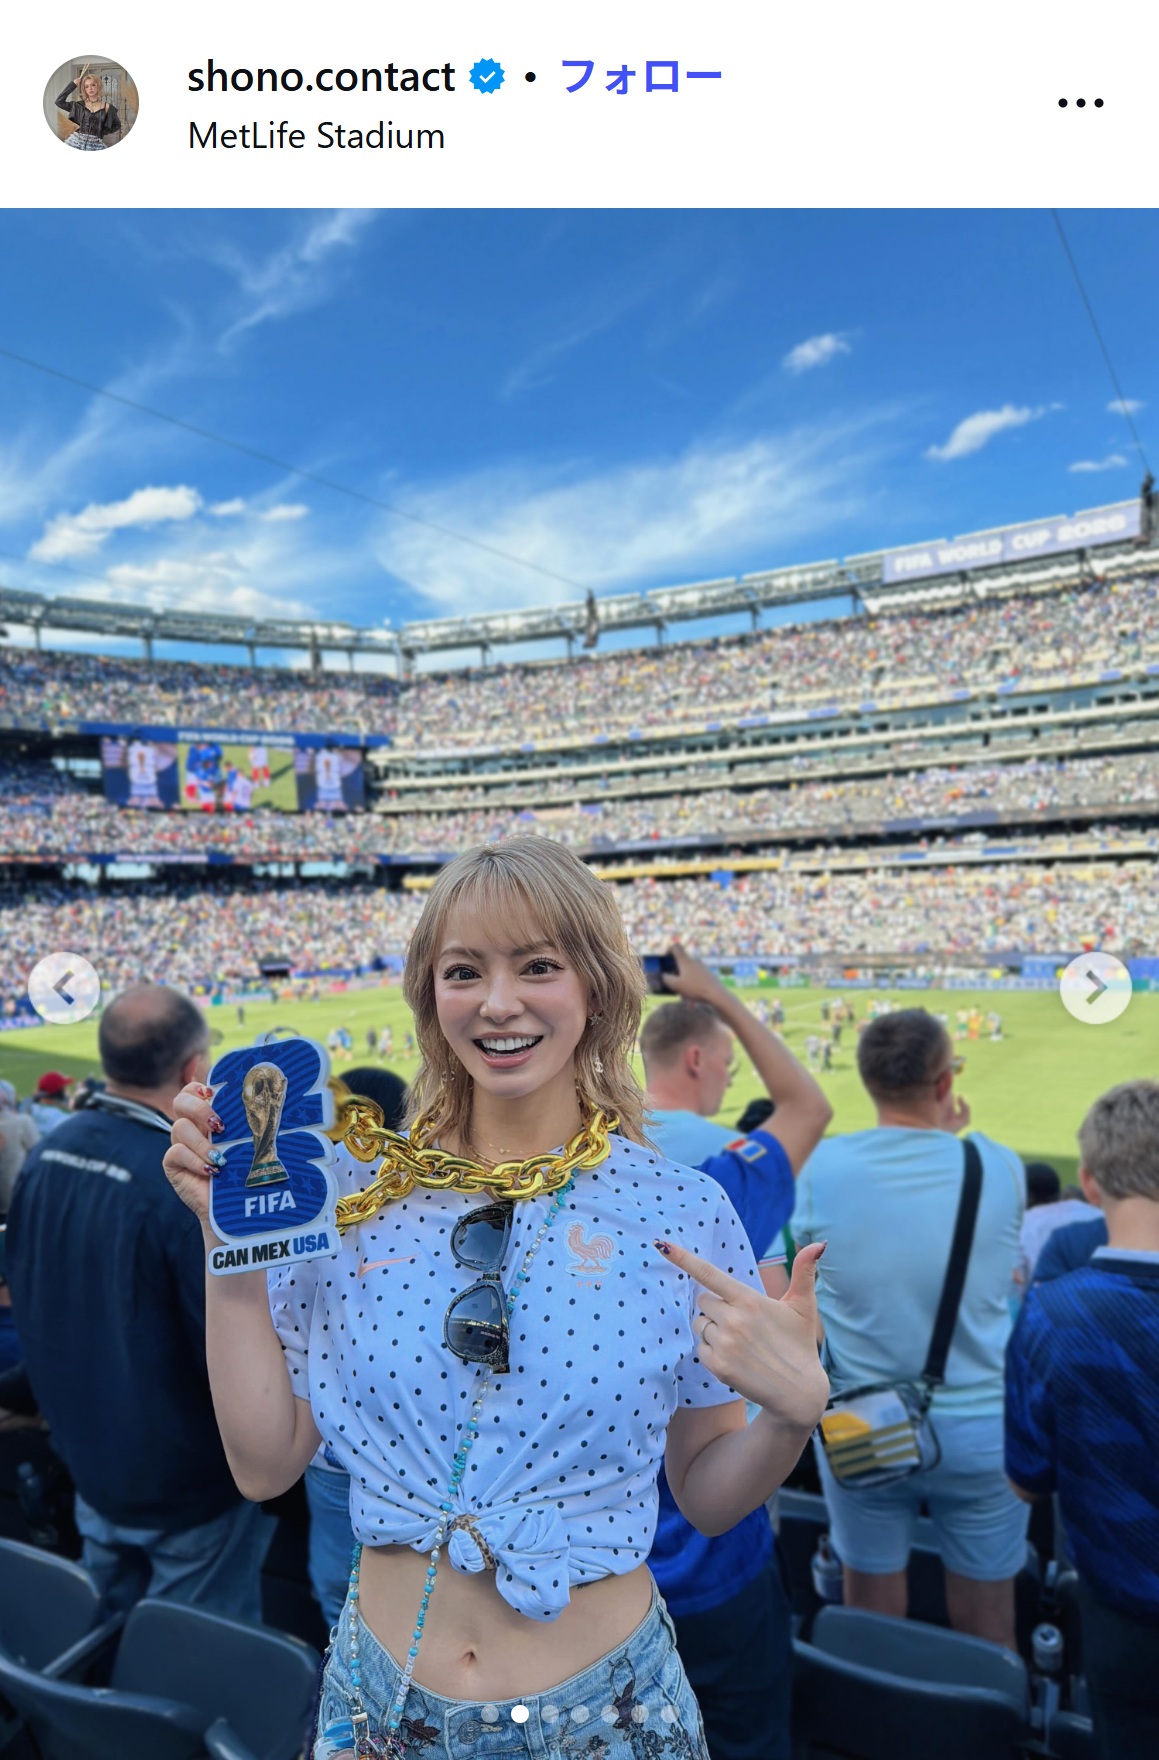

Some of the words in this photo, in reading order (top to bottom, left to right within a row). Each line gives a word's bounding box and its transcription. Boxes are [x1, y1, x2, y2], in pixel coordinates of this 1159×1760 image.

[895, 555, 932, 573] FIFA
[938, 540, 1002, 566] WORLD
[1012, 530, 1050, 550] CUP
[1057, 515, 1126, 541] 2026
[245, 1190, 296, 1218] FIFA
[213, 1248, 248, 1270] CAN
[252, 1239, 291, 1263] MEX
[293, 1232, 330, 1256] USA
